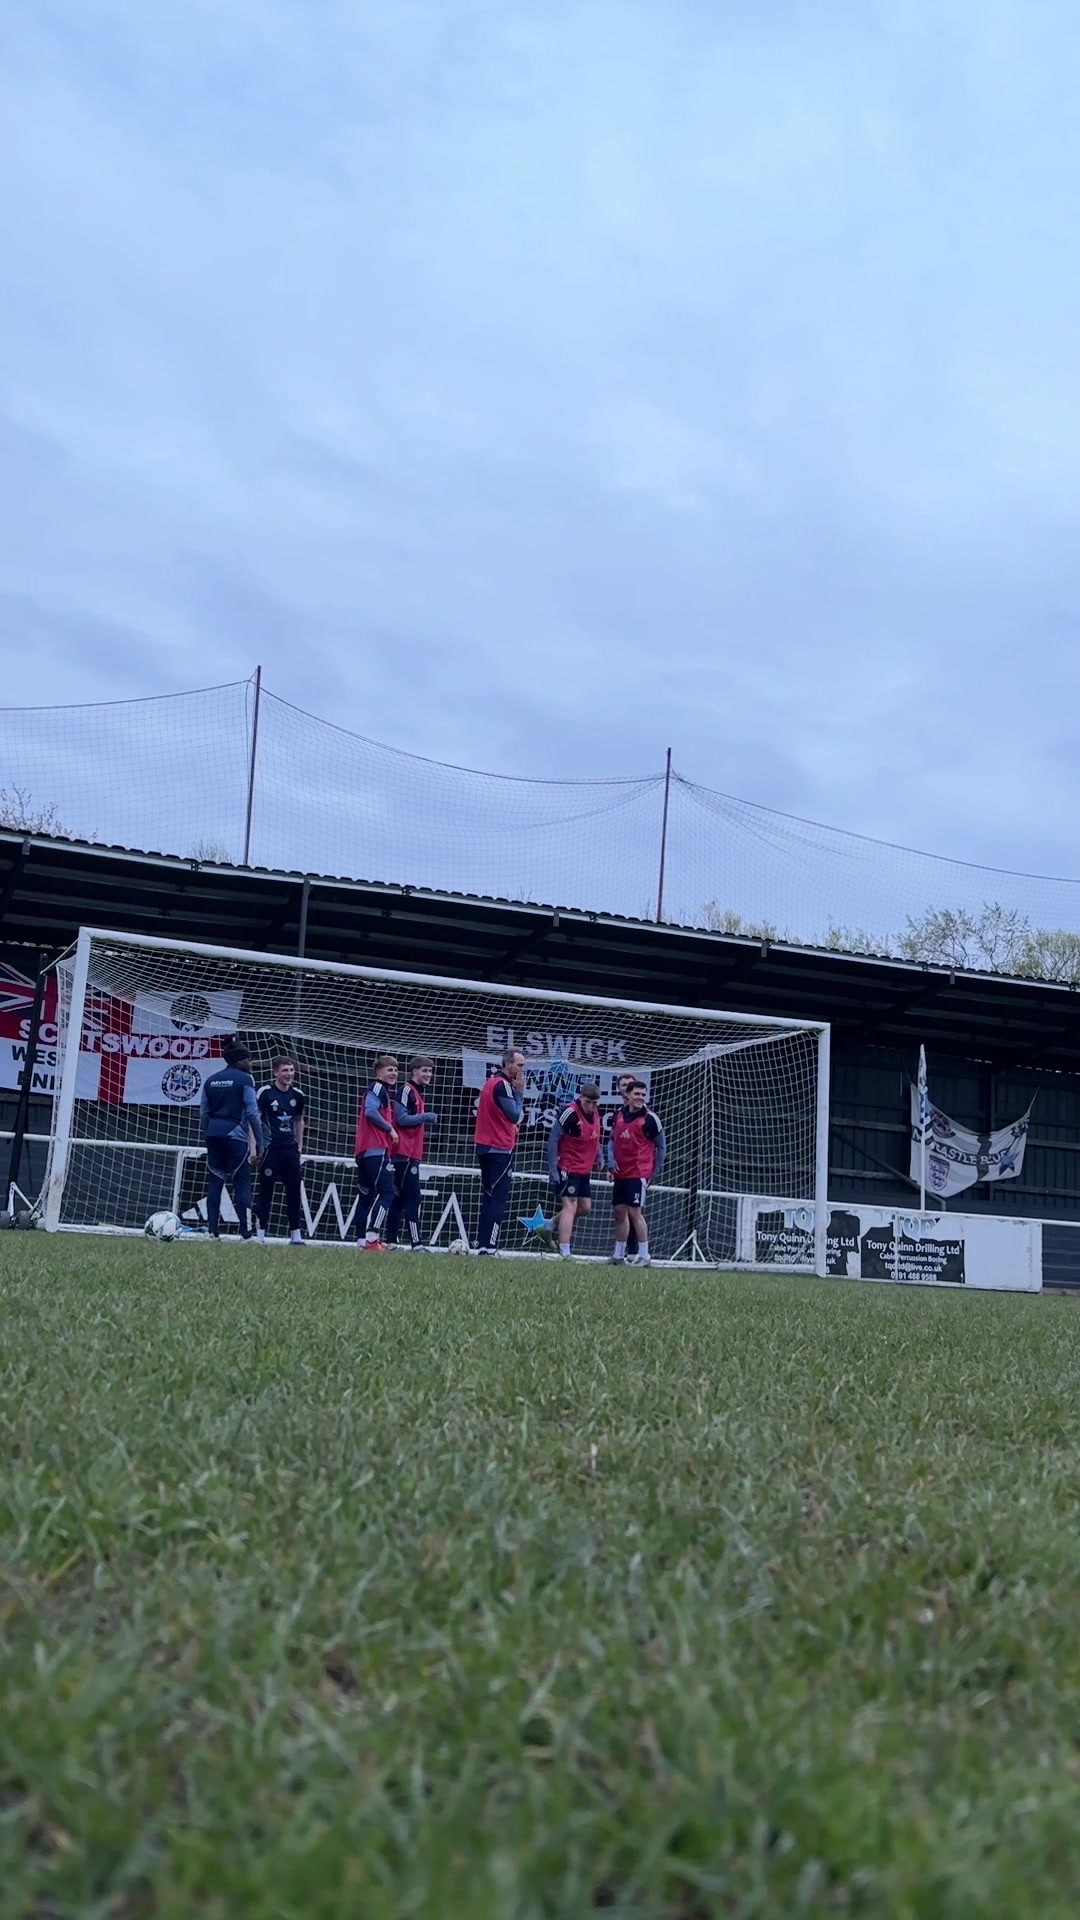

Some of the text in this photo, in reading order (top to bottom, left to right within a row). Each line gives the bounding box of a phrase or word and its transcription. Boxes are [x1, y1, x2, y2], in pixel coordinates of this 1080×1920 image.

[19, 1019, 209, 1059] SCTSWOOD
[486, 1025, 626, 1061] ELSWICK
[12, 1044, 64, 1067] WES
[756, 1231, 777, 1243] Tony
[780, 1233, 805, 1244] Quinn
[841, 1237, 855, 1247] Ltd
[866, 1240, 960, 1256] Tony Quinn Drilling Ltd
[890, 1271, 907, 1280] 091
